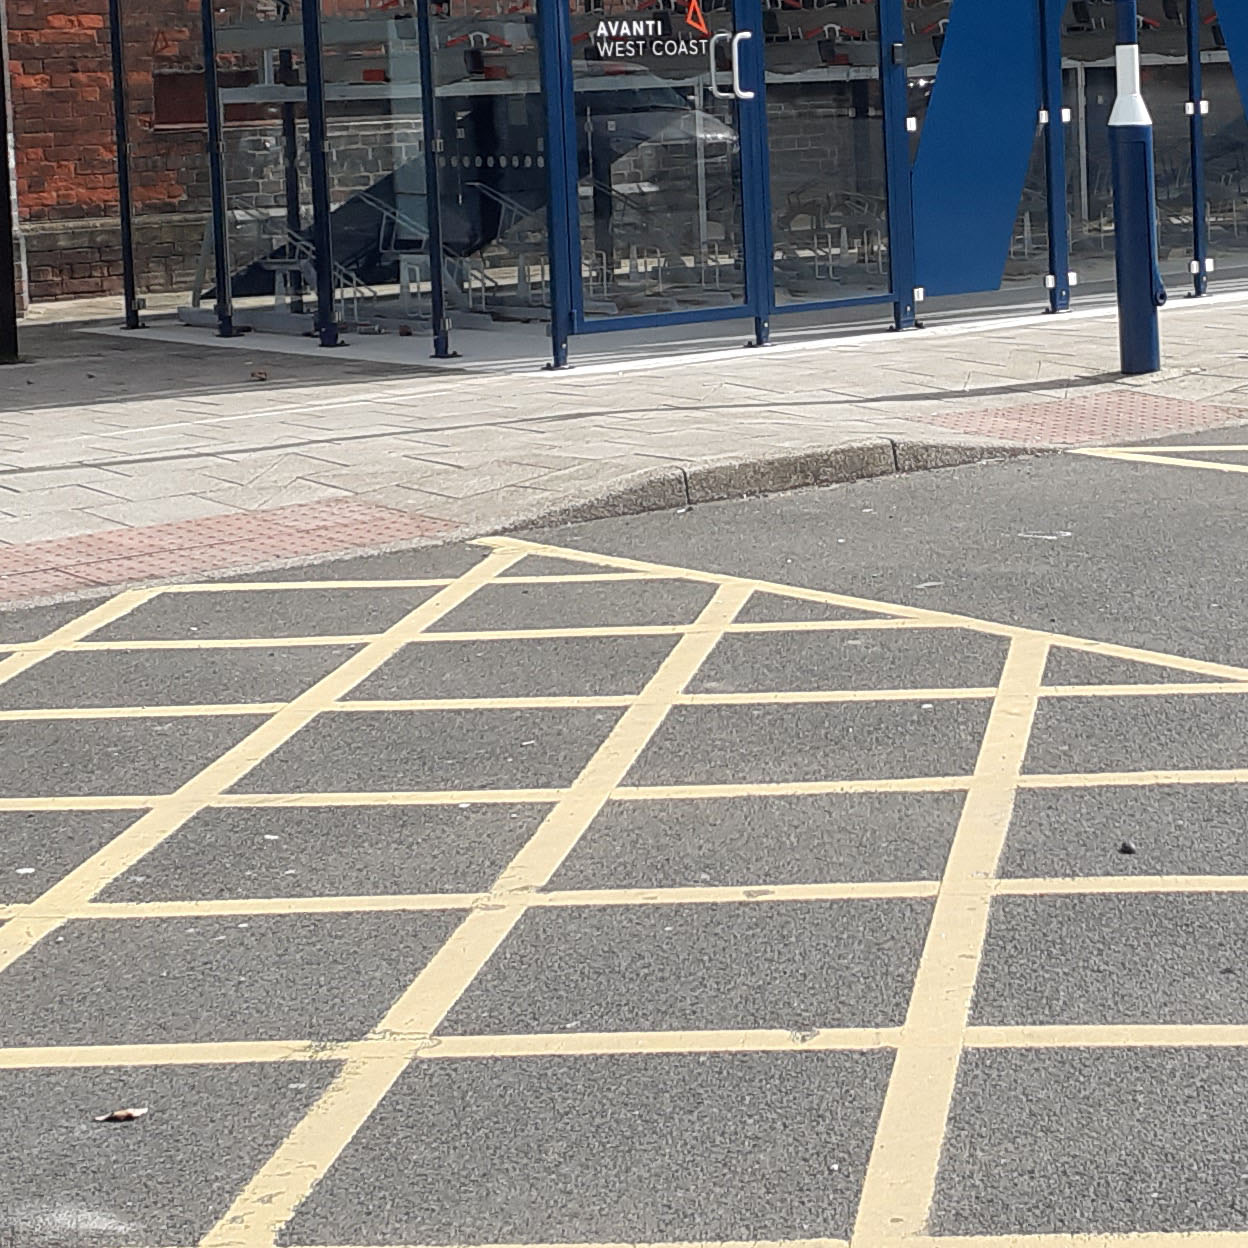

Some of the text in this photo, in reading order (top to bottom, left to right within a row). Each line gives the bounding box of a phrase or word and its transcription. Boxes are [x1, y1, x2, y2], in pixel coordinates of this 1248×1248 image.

[596, 20, 663, 37] AVANTI
[596, 39, 709, 57] WEST COAST
